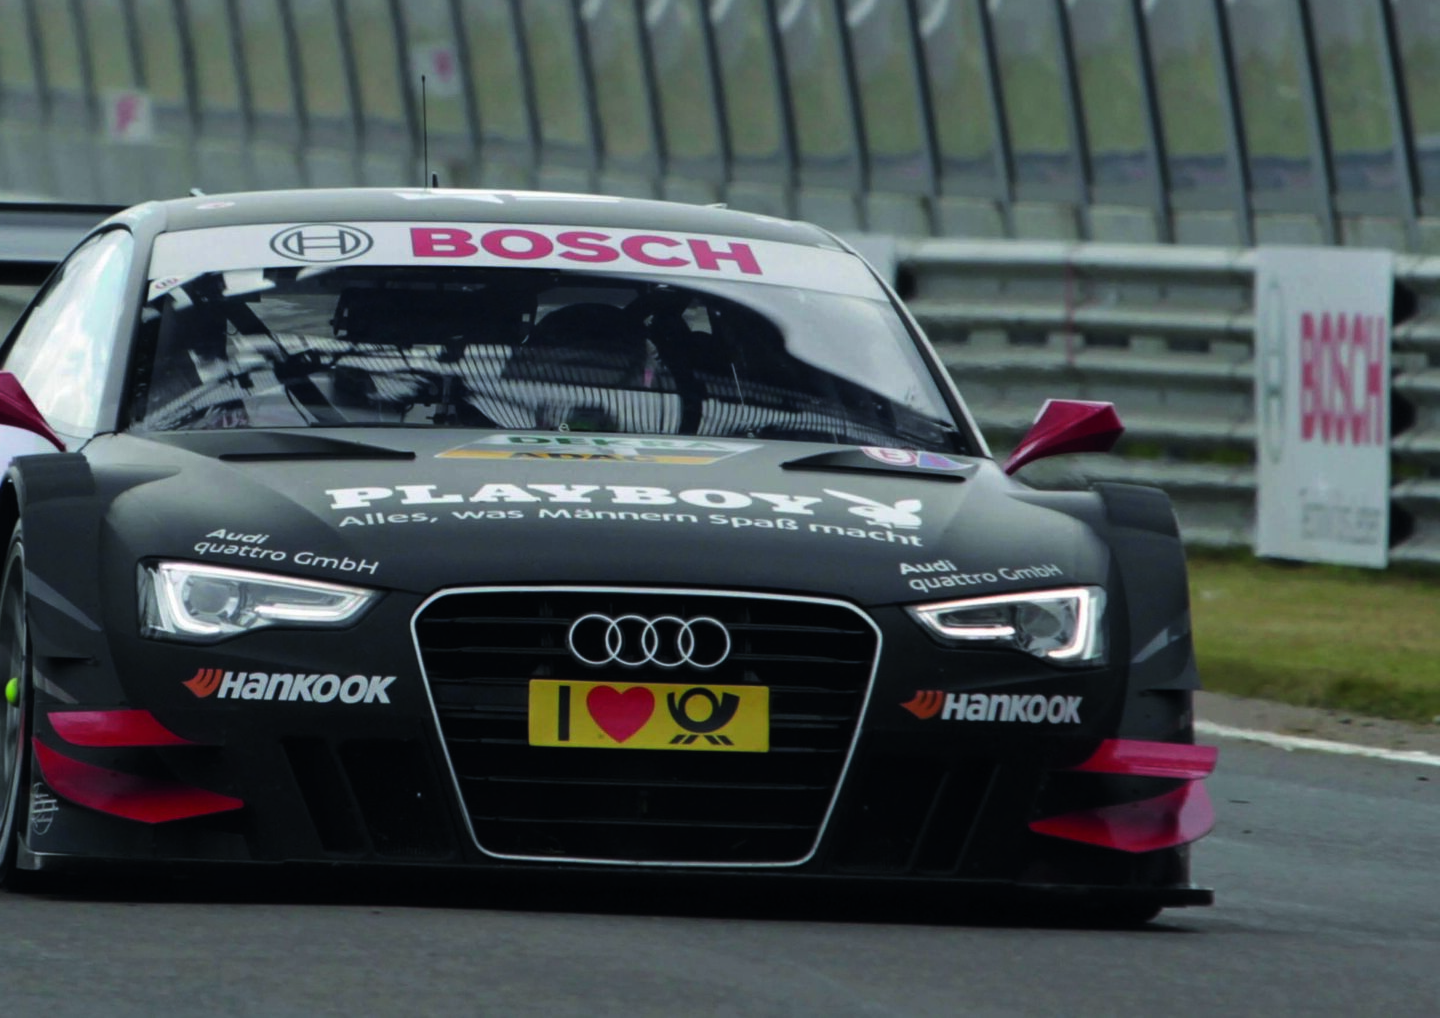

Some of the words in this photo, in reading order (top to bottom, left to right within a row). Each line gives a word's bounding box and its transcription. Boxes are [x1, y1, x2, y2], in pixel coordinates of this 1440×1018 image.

[410, 227, 763, 275] BOSCH
[1300, 312, 1384, 446] BOSCH
[507, 435, 732, 450] DEKRA
[325, 484, 822, 515] PLAYBOY
[206, 528, 270, 544] Audi
[339, 512, 438, 527] Alles,
[452, 509, 524, 519] was
[538, 508, 698, 523] Männern
[709, 513, 799, 531] Spaß
[809, 523, 923, 547] macht
[194, 541, 287, 561] quattro
[293, 551, 380, 574] GmbH
[899, 559, 958, 575] Audi
[909, 572, 998, 593] quattro
[997, 563, 1063, 581] GmbH
[558, 685, 571, 742] I
